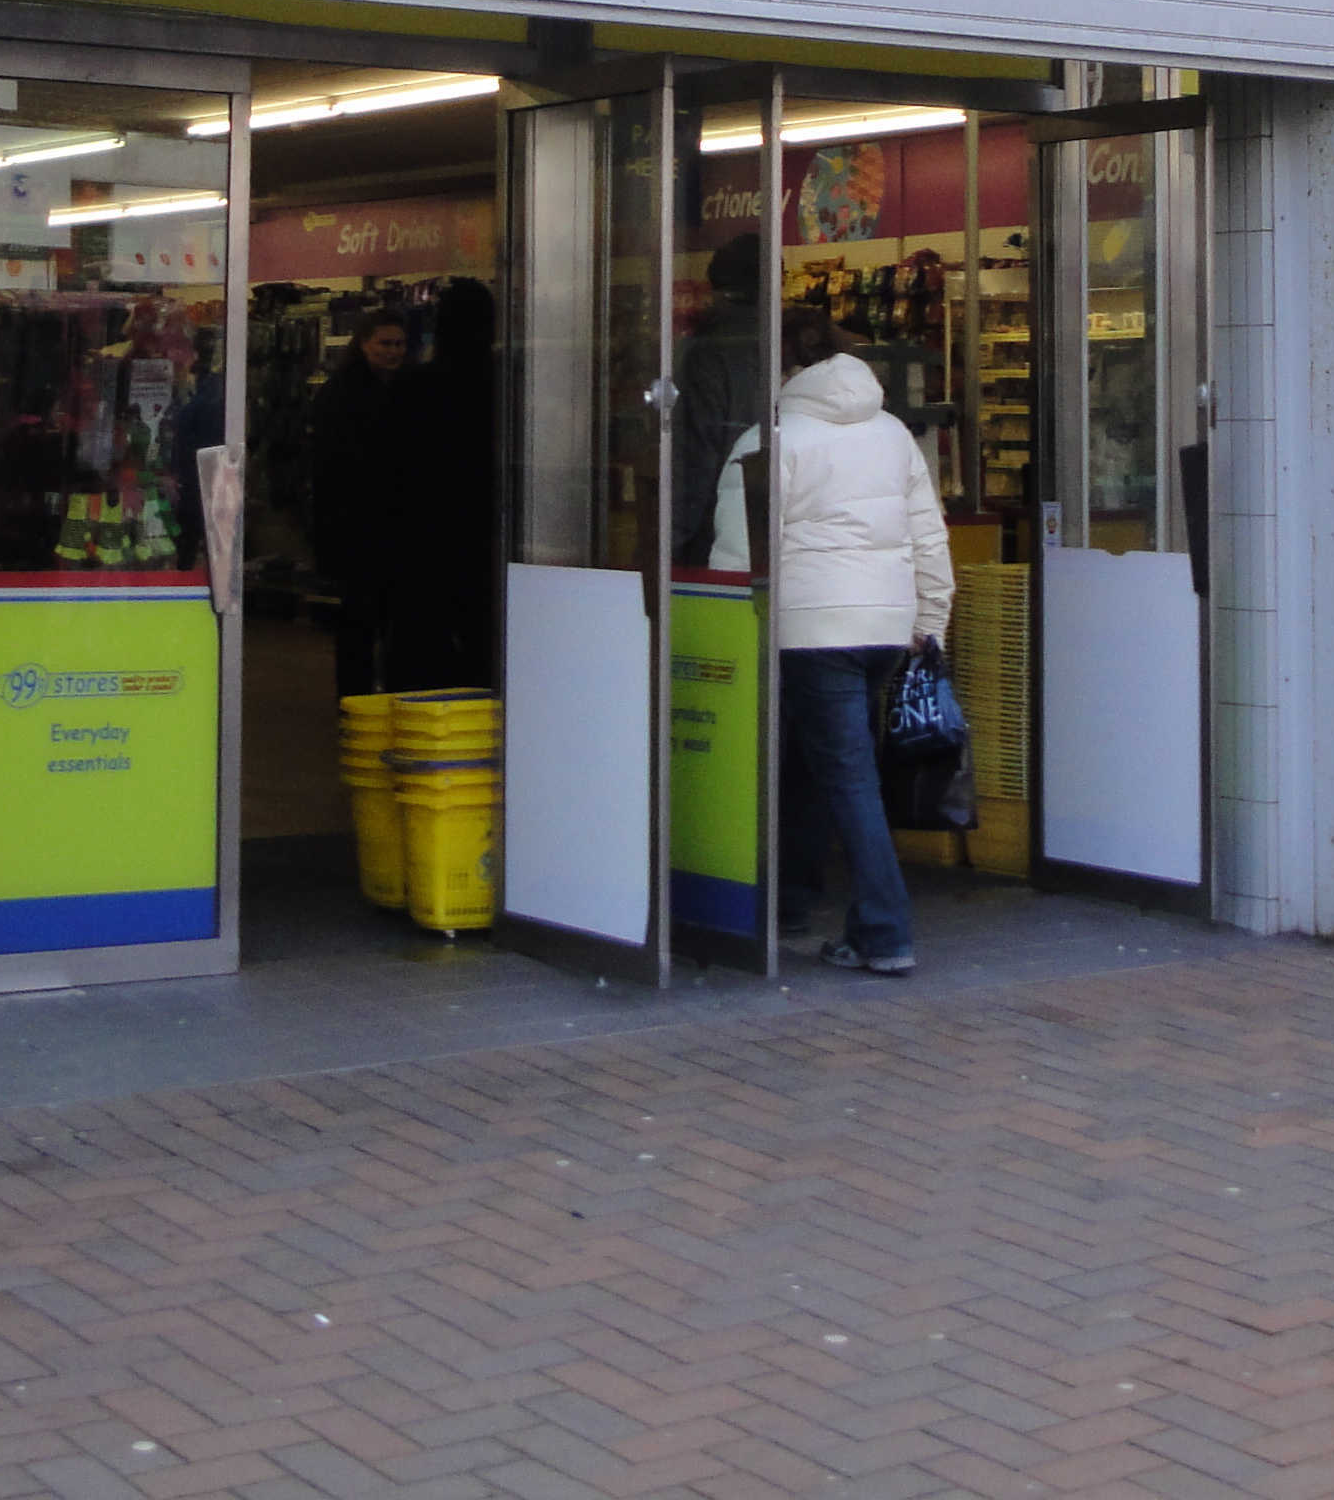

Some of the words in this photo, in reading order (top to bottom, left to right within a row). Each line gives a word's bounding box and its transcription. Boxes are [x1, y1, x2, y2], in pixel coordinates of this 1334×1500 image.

[336, 220, 380, 255] Soft
[54, 675, 119, 694] stores
[889, 697, 944, 733] ONE
[49, 722, 131, 745] Everyday
[46, 752, 133, 773] essentials
